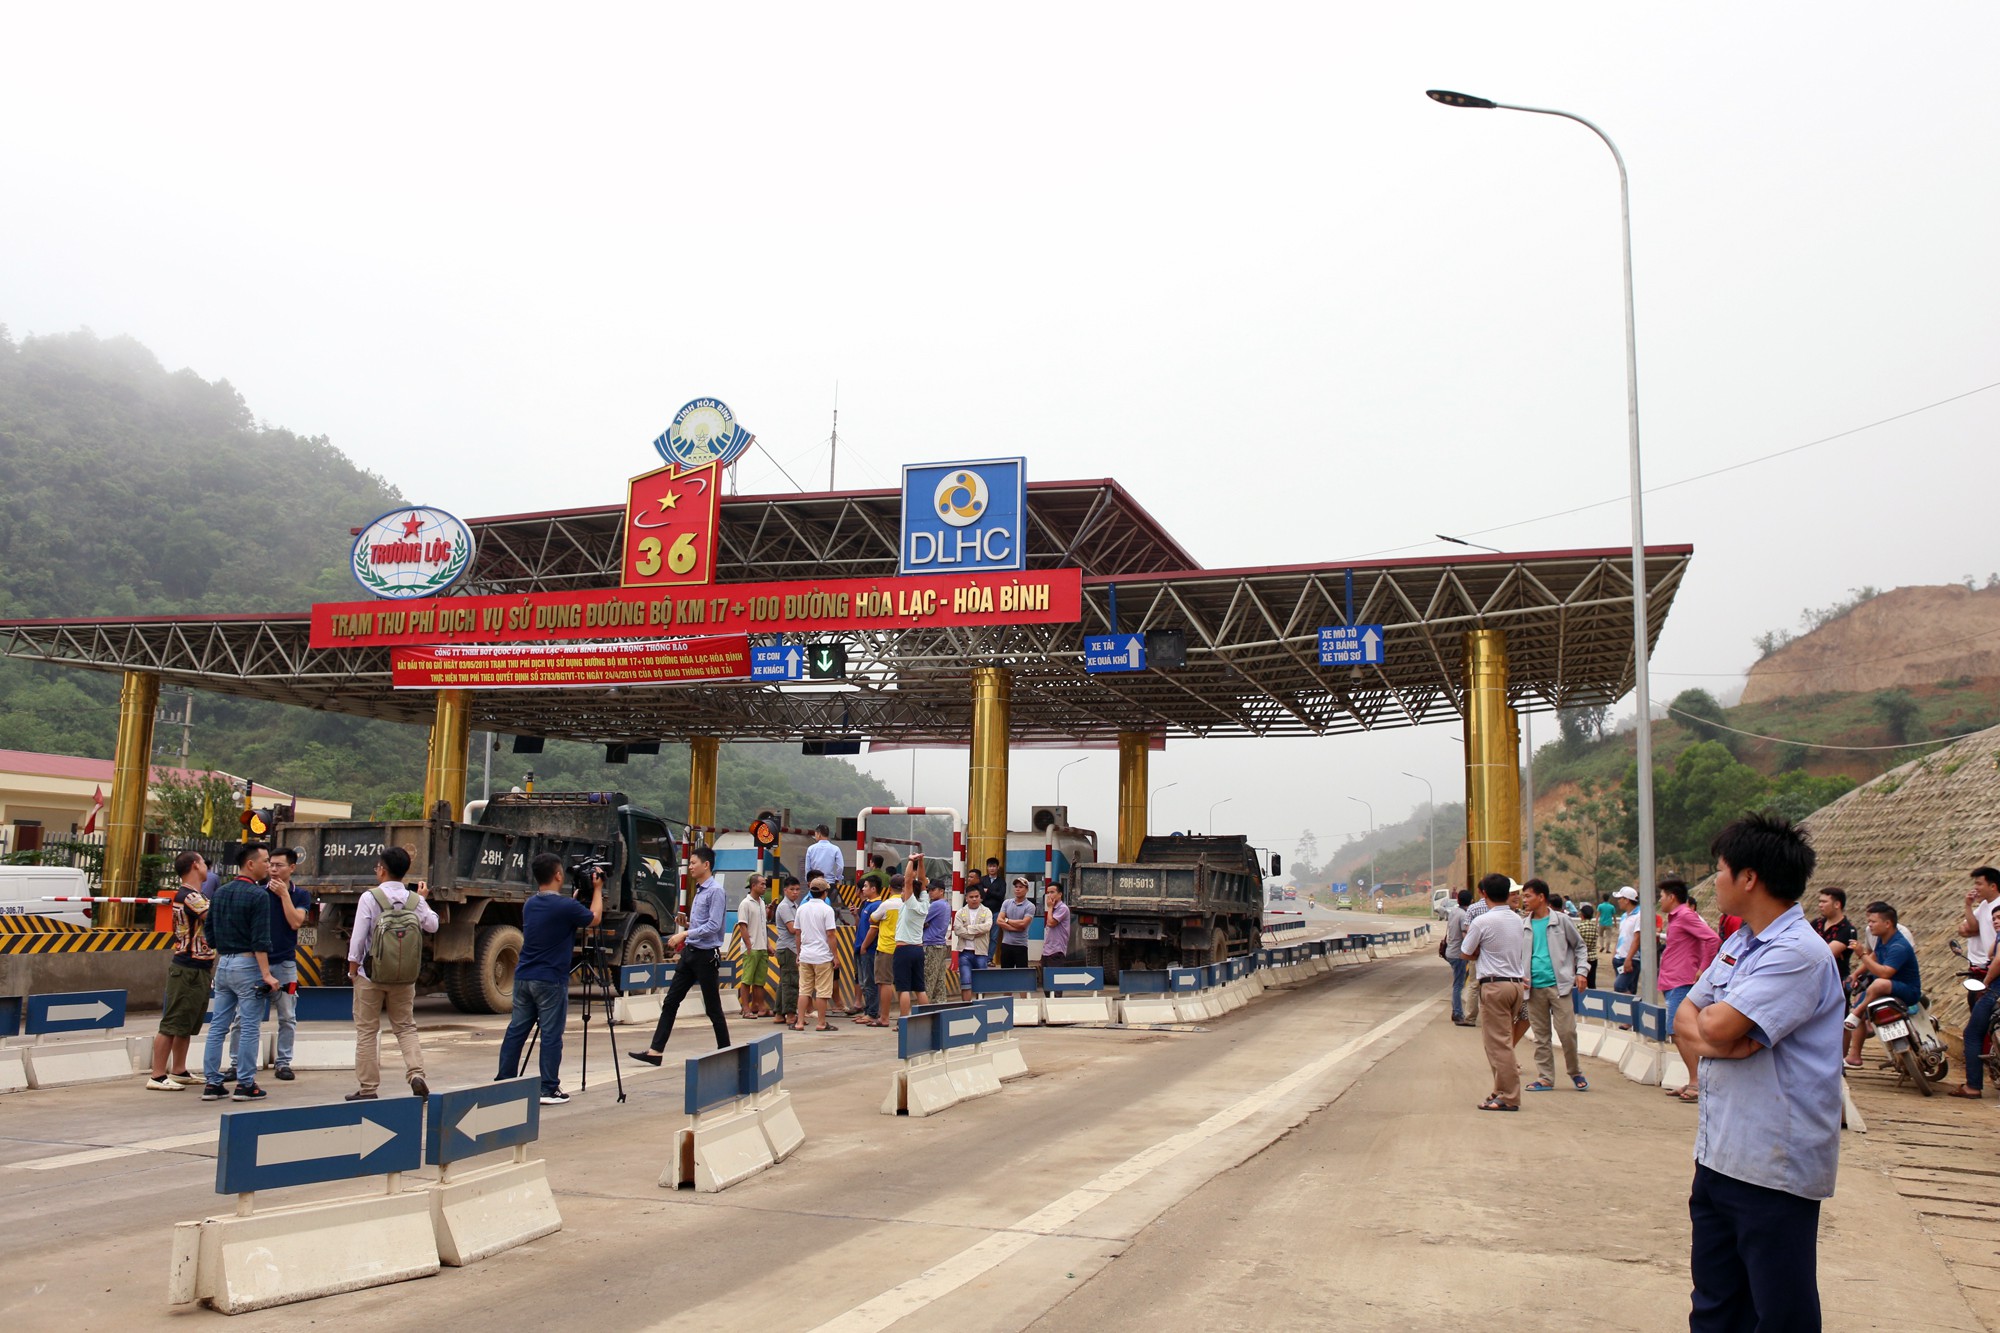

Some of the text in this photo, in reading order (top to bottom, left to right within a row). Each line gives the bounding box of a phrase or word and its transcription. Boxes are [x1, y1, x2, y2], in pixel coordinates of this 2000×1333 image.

[696, 398, 716, 408] HÒA
[370, 537, 451, 567] TRƯỜNG LỘC
[910, 527, 1011, 565] DLHC
[635, 533, 698, 576] 36
[331, 613, 373, 640] TRẠM
[377, 611, 406, 635] THU
[408, 603, 434, 633] PHÍ
[438, 608, 476, 637] DỊCH
[482, 607, 504, 636] VỤ
[508, 597, 533, 630] SỬ
[535, 604, 581, 634] DỤNG
[586, 597, 645, 627] ĐƯỜNG
[650, 595, 672, 630] BỘ
[676, 599, 705, 624] KM
[784, 588, 849, 619] ĐƯỜNG
[855, 585, 893, 618] HÒA
[898, 589, 936, 621] LẠC
[954, 581, 994, 614] HÒA
[1000, 579, 1050, 612] BÌNH
[1322, 627, 1357, 639] XE MÔ TÔ
[462, 648, 479, 656] TNHH
[620, 644, 644, 654] TRỌNG
[1091, 639, 1115, 651] XE TẢI
[1322, 639, 1358, 651] 2,3 BÁNH
[444, 659, 458, 669] NGÀY
[459, 660, 490, 669] 03/05/2019
[491, 660, 507, 670] TRẠM
[508, 659, 519, 668] THU
[520, 658, 531, 668] PHÍ
[531, 659, 546, 669] DỊCH
[547, 659, 555, 669] VỤ
[556, 656, 566, 668] SỬ
[566, 659, 583, 669] DỤNG
[584, 656, 606, 668] ĐƯỜNG
[607, 656, 616, 668] BỘ
[617, 657, 629, 667] KM
[630, 657, 655, 666] 17+100
[655, 654, 679, 666] ĐƯỜNG
[680, 654, 694, 664] HÒA
[725, 652, 744, 662] BÌNH
[757, 652, 781, 661] XE CON
[1087, 657, 1097, 666] XE
[1097, 654, 1112, 666] QUÁ
[1322, 650, 1362, 662] XE THÔ SƠ
[430, 673, 445, 684] THỰC
[445, 673, 458, 684] HIỆN
[459, 674, 469, 682] THU
[470, 672, 480, 682] PHÍ
[481, 673, 495, 682] THEO
[496, 671, 514, 682] QUYẾT
[515, 672, 529, 683] ĐỊNH
[530, 670, 540, 681] SỐ
[587, 670, 604, 679] NGÀY
[605, 670, 637, 679] 24/4/2019
[638, 667, 652, 679] CỦA
[654, 668, 663, 679] BỘ
[664, 668, 681, 678] GIAO
[682, 667, 705, 677] THÔNG
[706, 665, 721, 677] VẬN
[721, 663, 734, 674] TẢI
[753, 664, 785, 675] XE KHÁCH
[1120, 877, 1154, 889] 28H-5013
